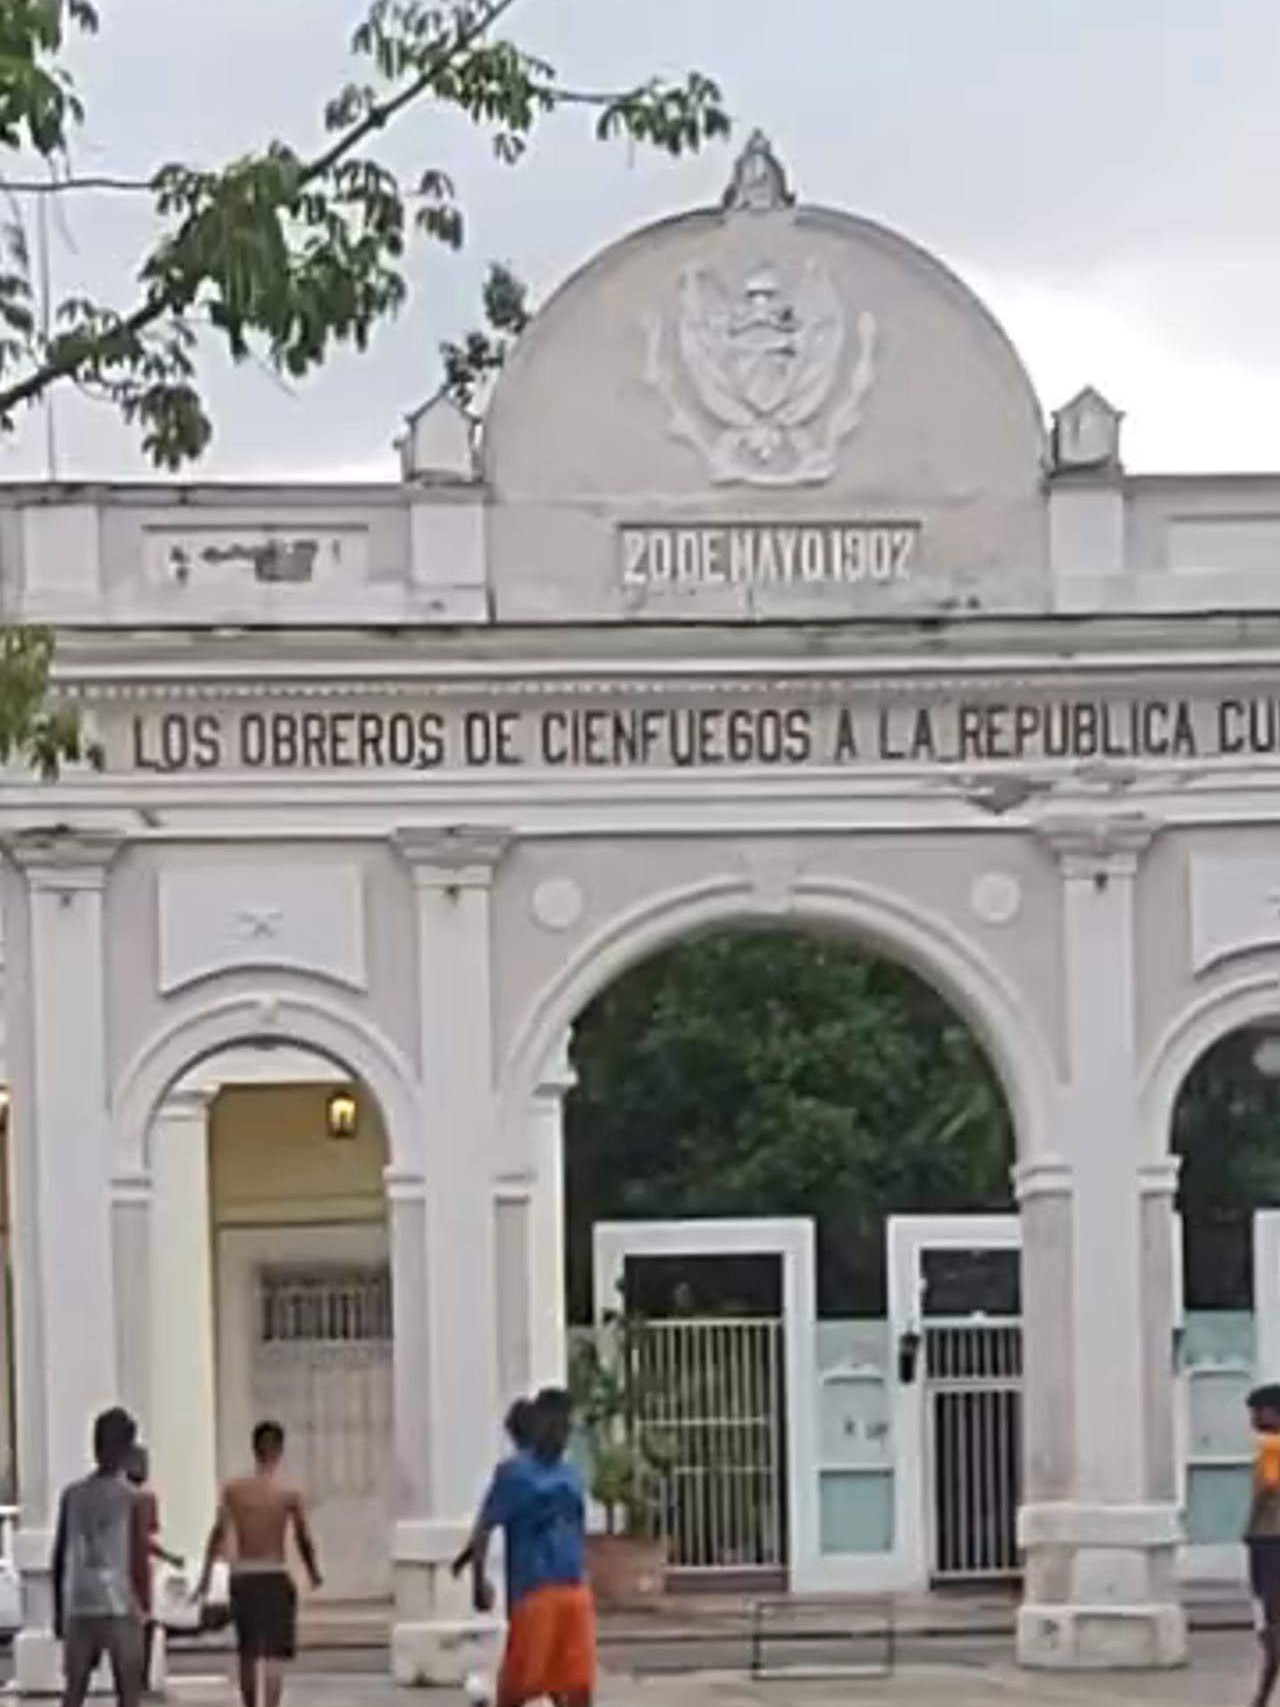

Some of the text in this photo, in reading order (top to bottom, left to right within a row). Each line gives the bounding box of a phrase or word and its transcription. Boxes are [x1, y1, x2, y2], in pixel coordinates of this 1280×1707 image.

[676, 529, 726, 583] DE
[729, 529, 825, 583] MAYO
[832, 527, 915, 582] 1902
[131, 711, 221, 771] LOS
[239, 710, 446, 769] OBREROS
[463, 710, 523, 767] DE
[540, 707, 812, 768] CIENFUEGOS
[833, 705, 860, 762] A
[878, 704, 936, 760] LA
[957, 699, 1198, 761] REPUBLICA
